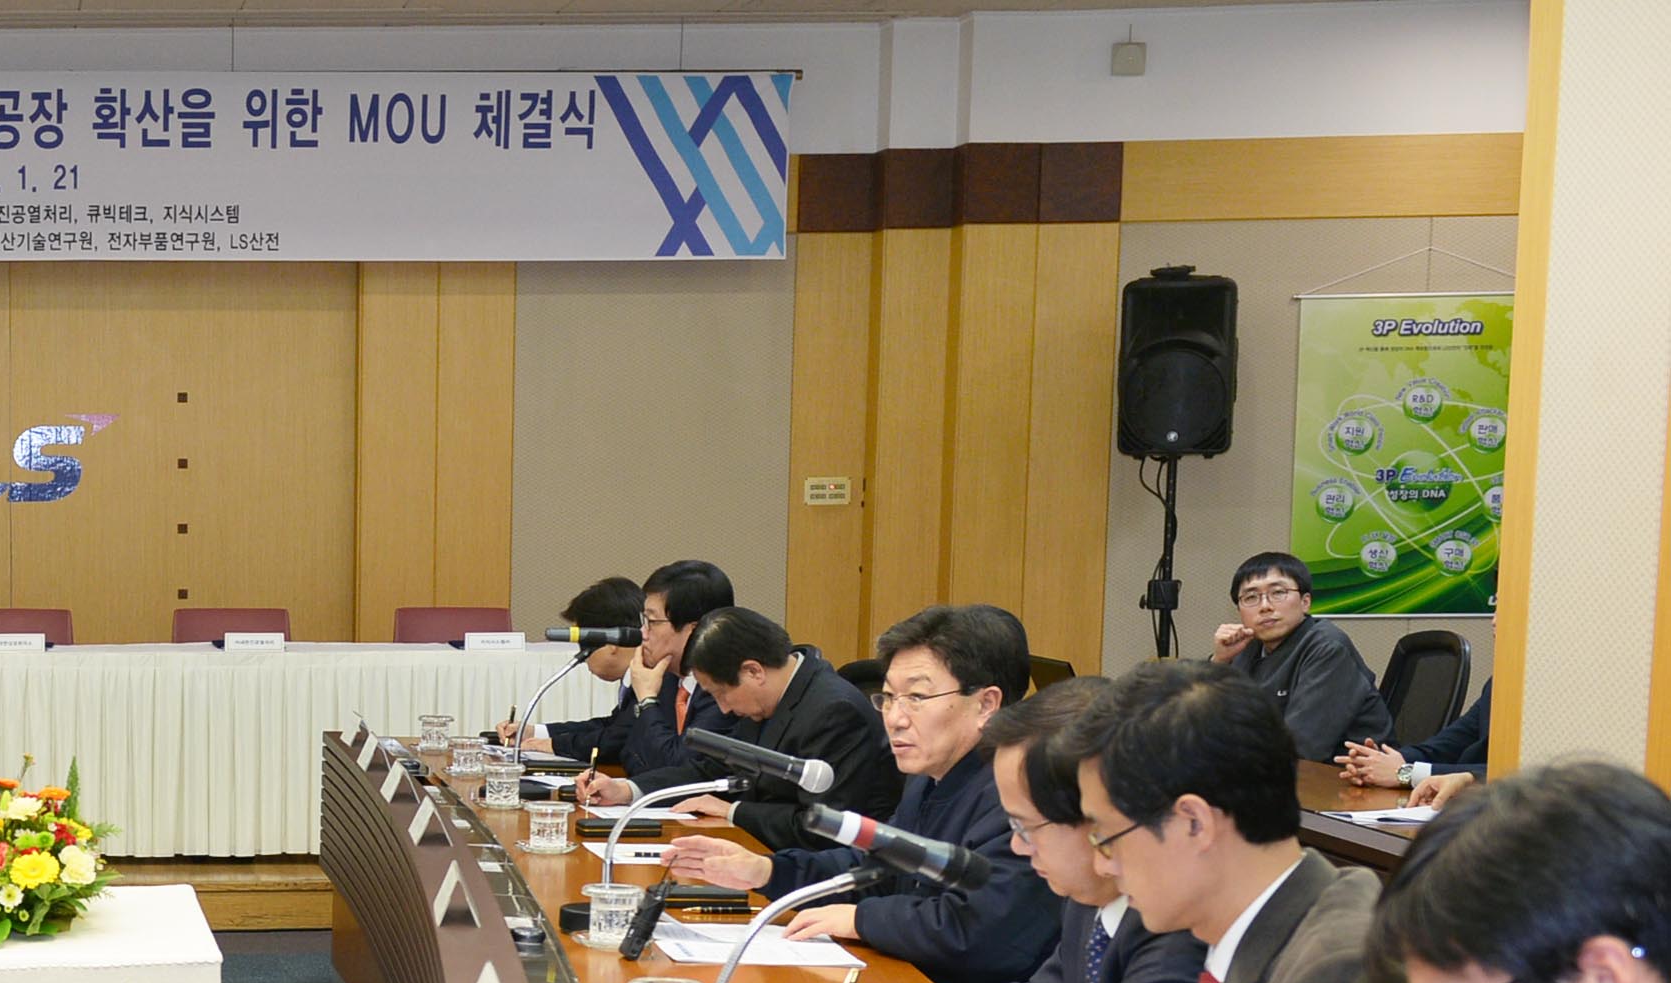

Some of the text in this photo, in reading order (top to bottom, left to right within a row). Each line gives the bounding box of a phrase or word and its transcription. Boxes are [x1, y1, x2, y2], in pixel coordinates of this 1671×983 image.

[92, 87, 216, 149] 확산을
[242, 88, 324, 150] 위한
[348, 92, 447, 145] MOU
[472, 87, 598, 150] 체결식
[17, 165, 37, 193] 1.
[53, 164, 78, 190] 21
[86, 203, 154, 225] 큐빅테크,
[162, 204, 240, 225] 지식시스템
[107, 231, 221, 253] 전자부품연구원,
[230, 231, 280, 252] LS산전
[1372, 319, 1483, 335] 3P Evolution
[1412, 394, 1434, 404] R&D
[1345, 426, 1365, 437] 지원
[1376, 469, 1397, 482] 3P
[1389, 489, 1446, 501] 성장의 DNA
[1369, 549, 1389, 560] 생산
